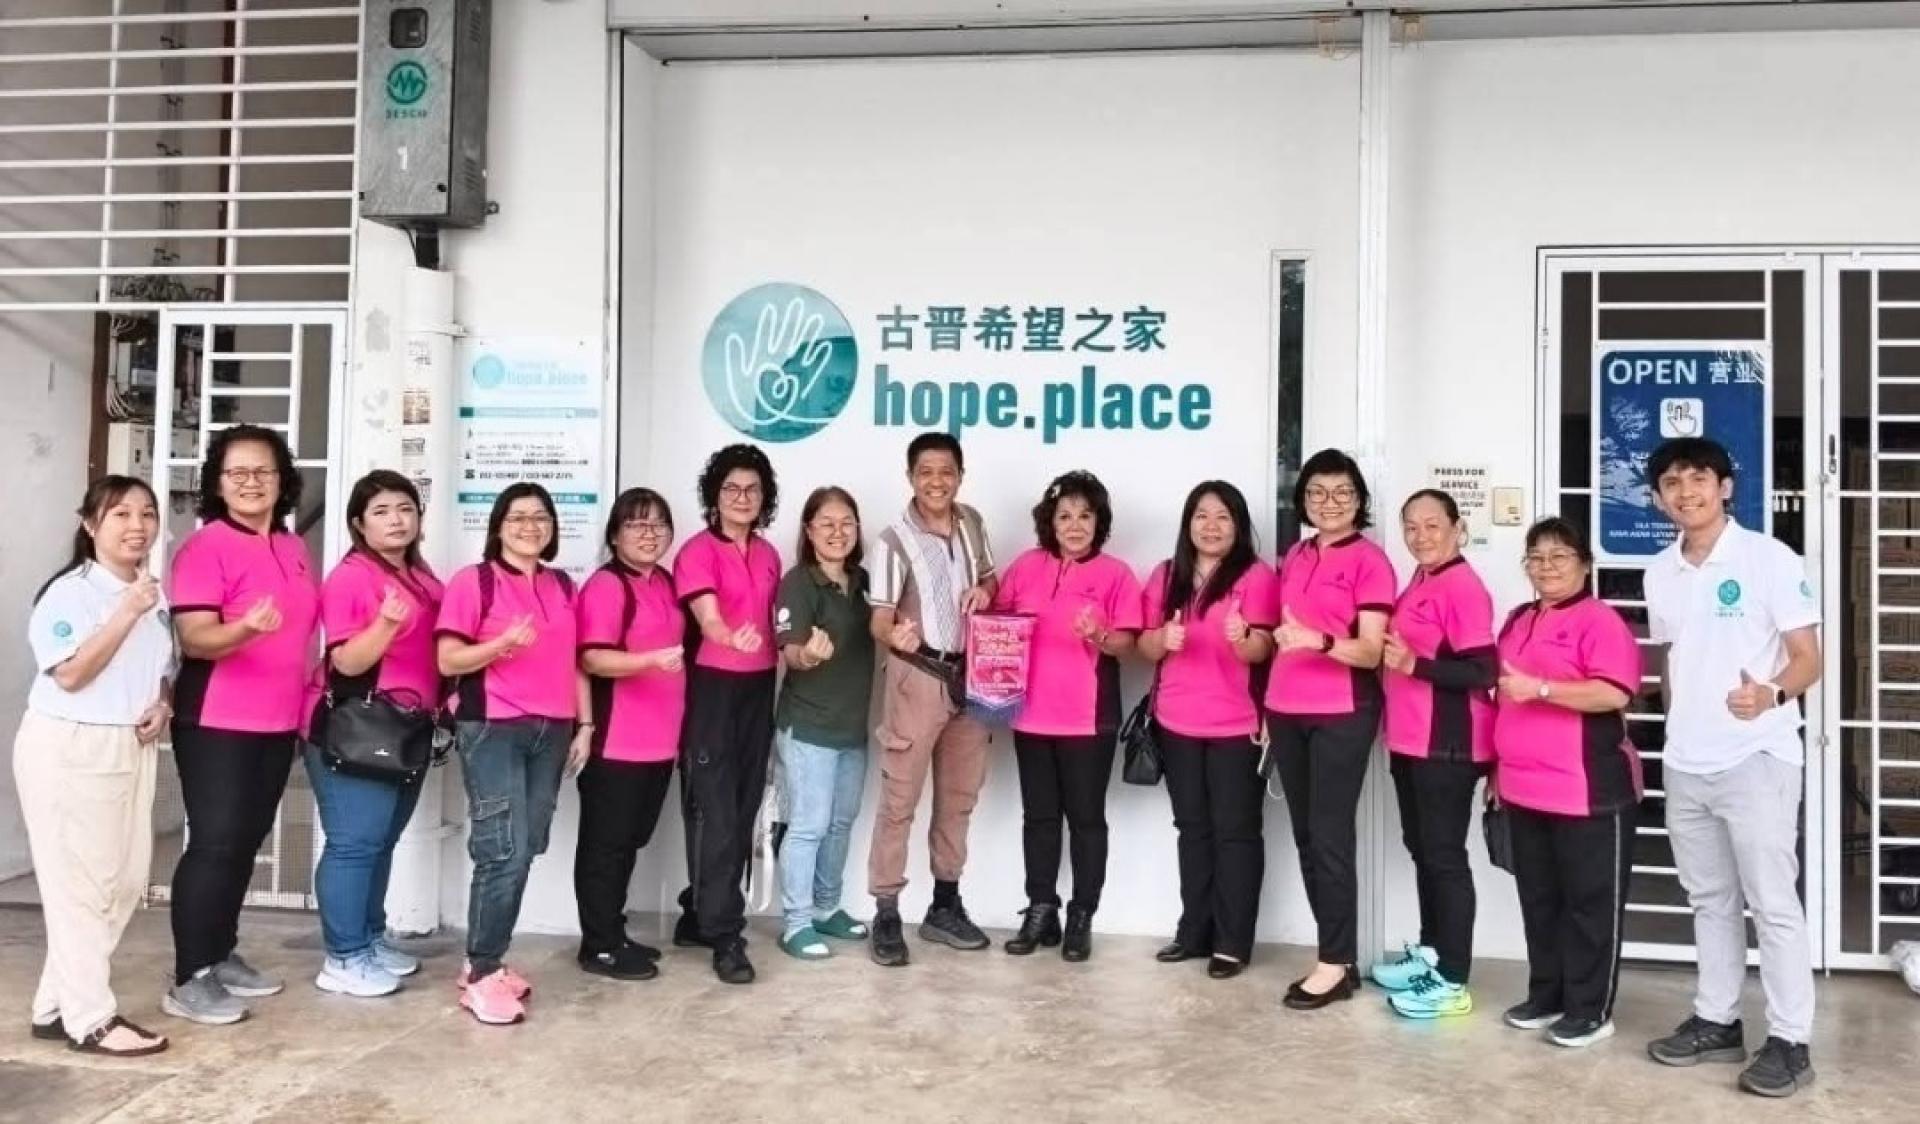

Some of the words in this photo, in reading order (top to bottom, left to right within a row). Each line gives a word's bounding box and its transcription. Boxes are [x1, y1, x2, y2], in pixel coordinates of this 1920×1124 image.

[398, 146, 408, 170] 1
[875, 306, 1168, 353] 古晋希望之家
[1608, 358, 1698, 385] OPEN
[873, 364, 1213, 444] hope.place
